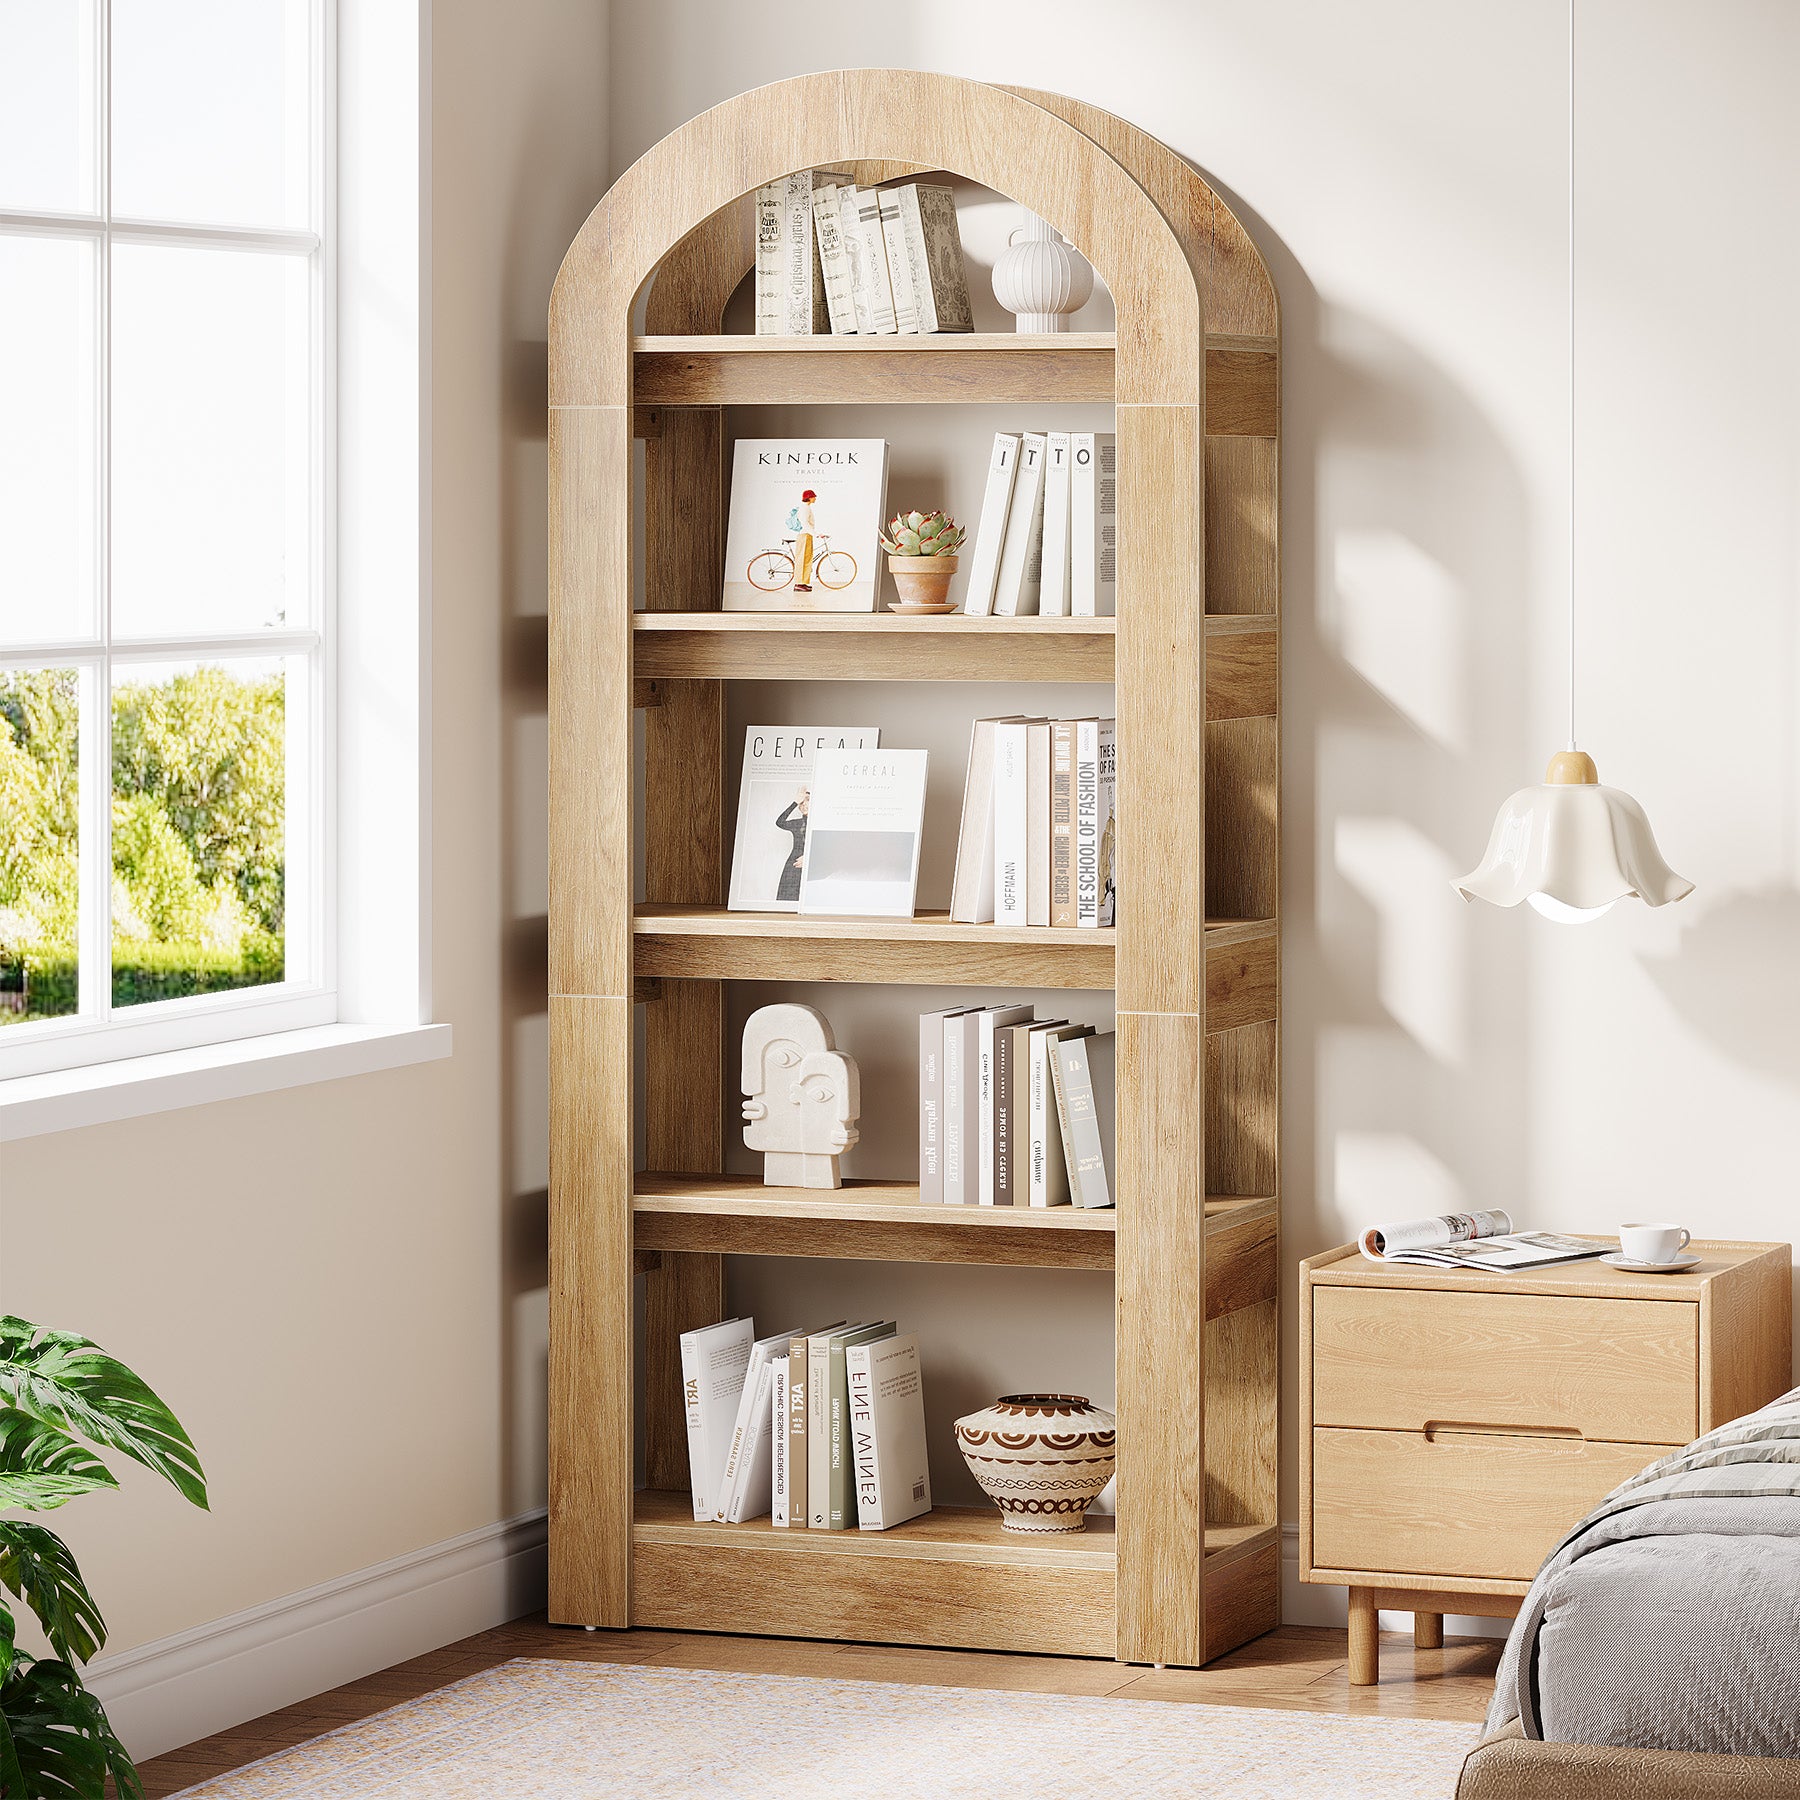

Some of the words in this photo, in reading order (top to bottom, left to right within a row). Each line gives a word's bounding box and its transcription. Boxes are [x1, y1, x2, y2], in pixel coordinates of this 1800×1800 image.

[758, 452, 859, 465] KINFOLK
[1001, 450, 1007, 467] I
[1028, 449, 1037, 466] T
[1054, 448, 1063, 464] T
[1076, 448, 1090, 465] O
[1054, 741, 1070, 772] ROWLING
[1099, 745, 1111, 759] THE
[842, 764, 896, 777] CEREAL
[1099, 760, 1107, 774] OF
[1054, 774, 1070, 797] HARRY
[1078, 760, 1096, 817] FASHION
[1054, 798, 1070, 823] POTTER
[1079, 819, 1096, 837] OF
[1054, 836, 1070, 869] CHAMBER
[1079, 839, 1096, 891] SCHOOL
[1004, 861, 1016, 911] HOFFMANN
[1054, 875, 1070, 904] SECRETS
[1079, 893, 1096, 920] THE
